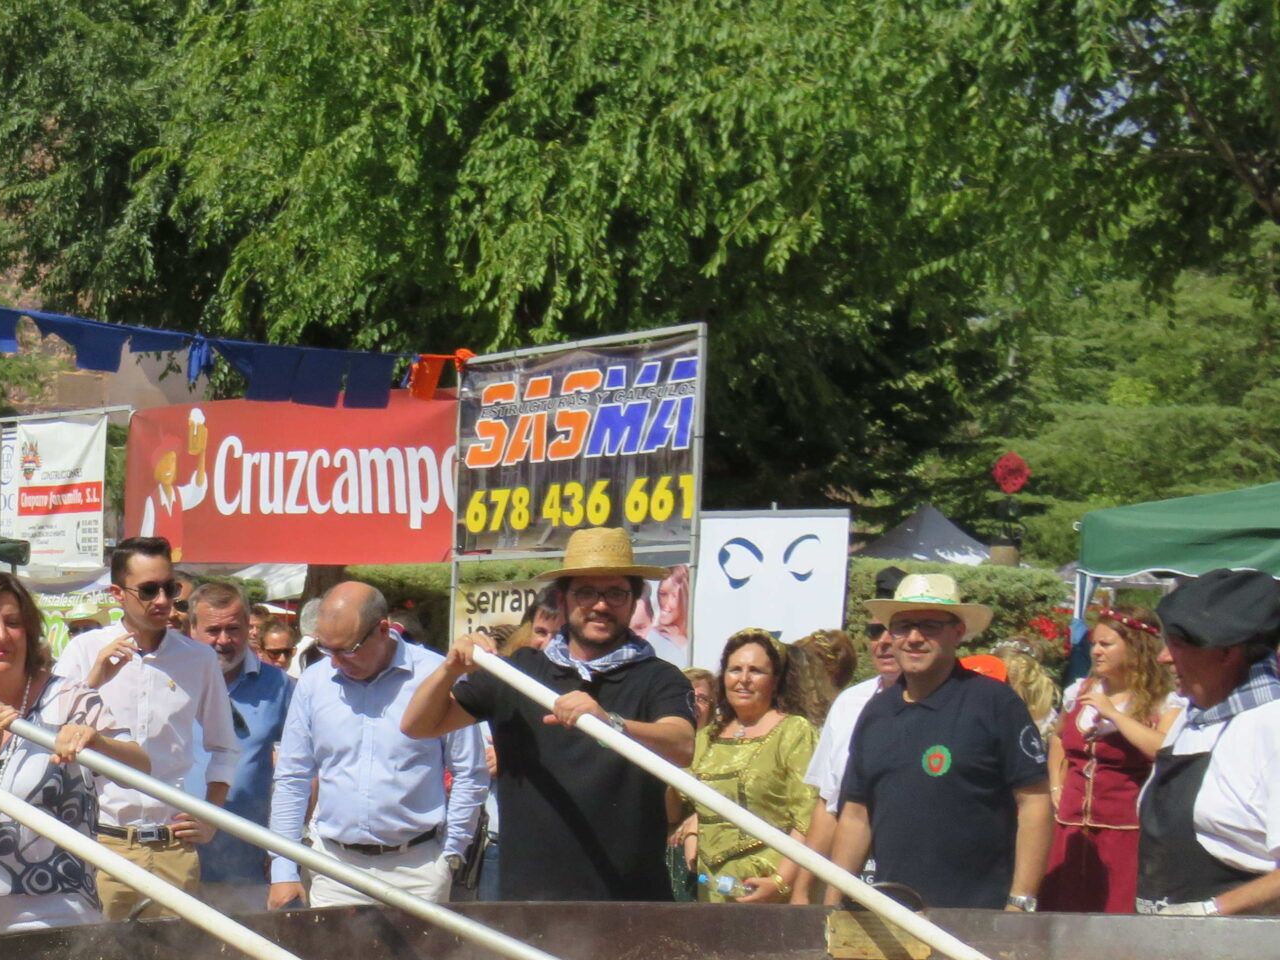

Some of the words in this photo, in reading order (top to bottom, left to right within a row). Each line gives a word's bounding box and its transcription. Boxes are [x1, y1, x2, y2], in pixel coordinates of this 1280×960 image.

[465, 357, 698, 468] SASMA
[479, 393, 590, 419] ESTRUCTURAS
[596, 390, 612, 406] Y
[466, 486, 530, 533] 678
[542, 480, 611, 527] 436
[625, 474, 694, 524] 661
